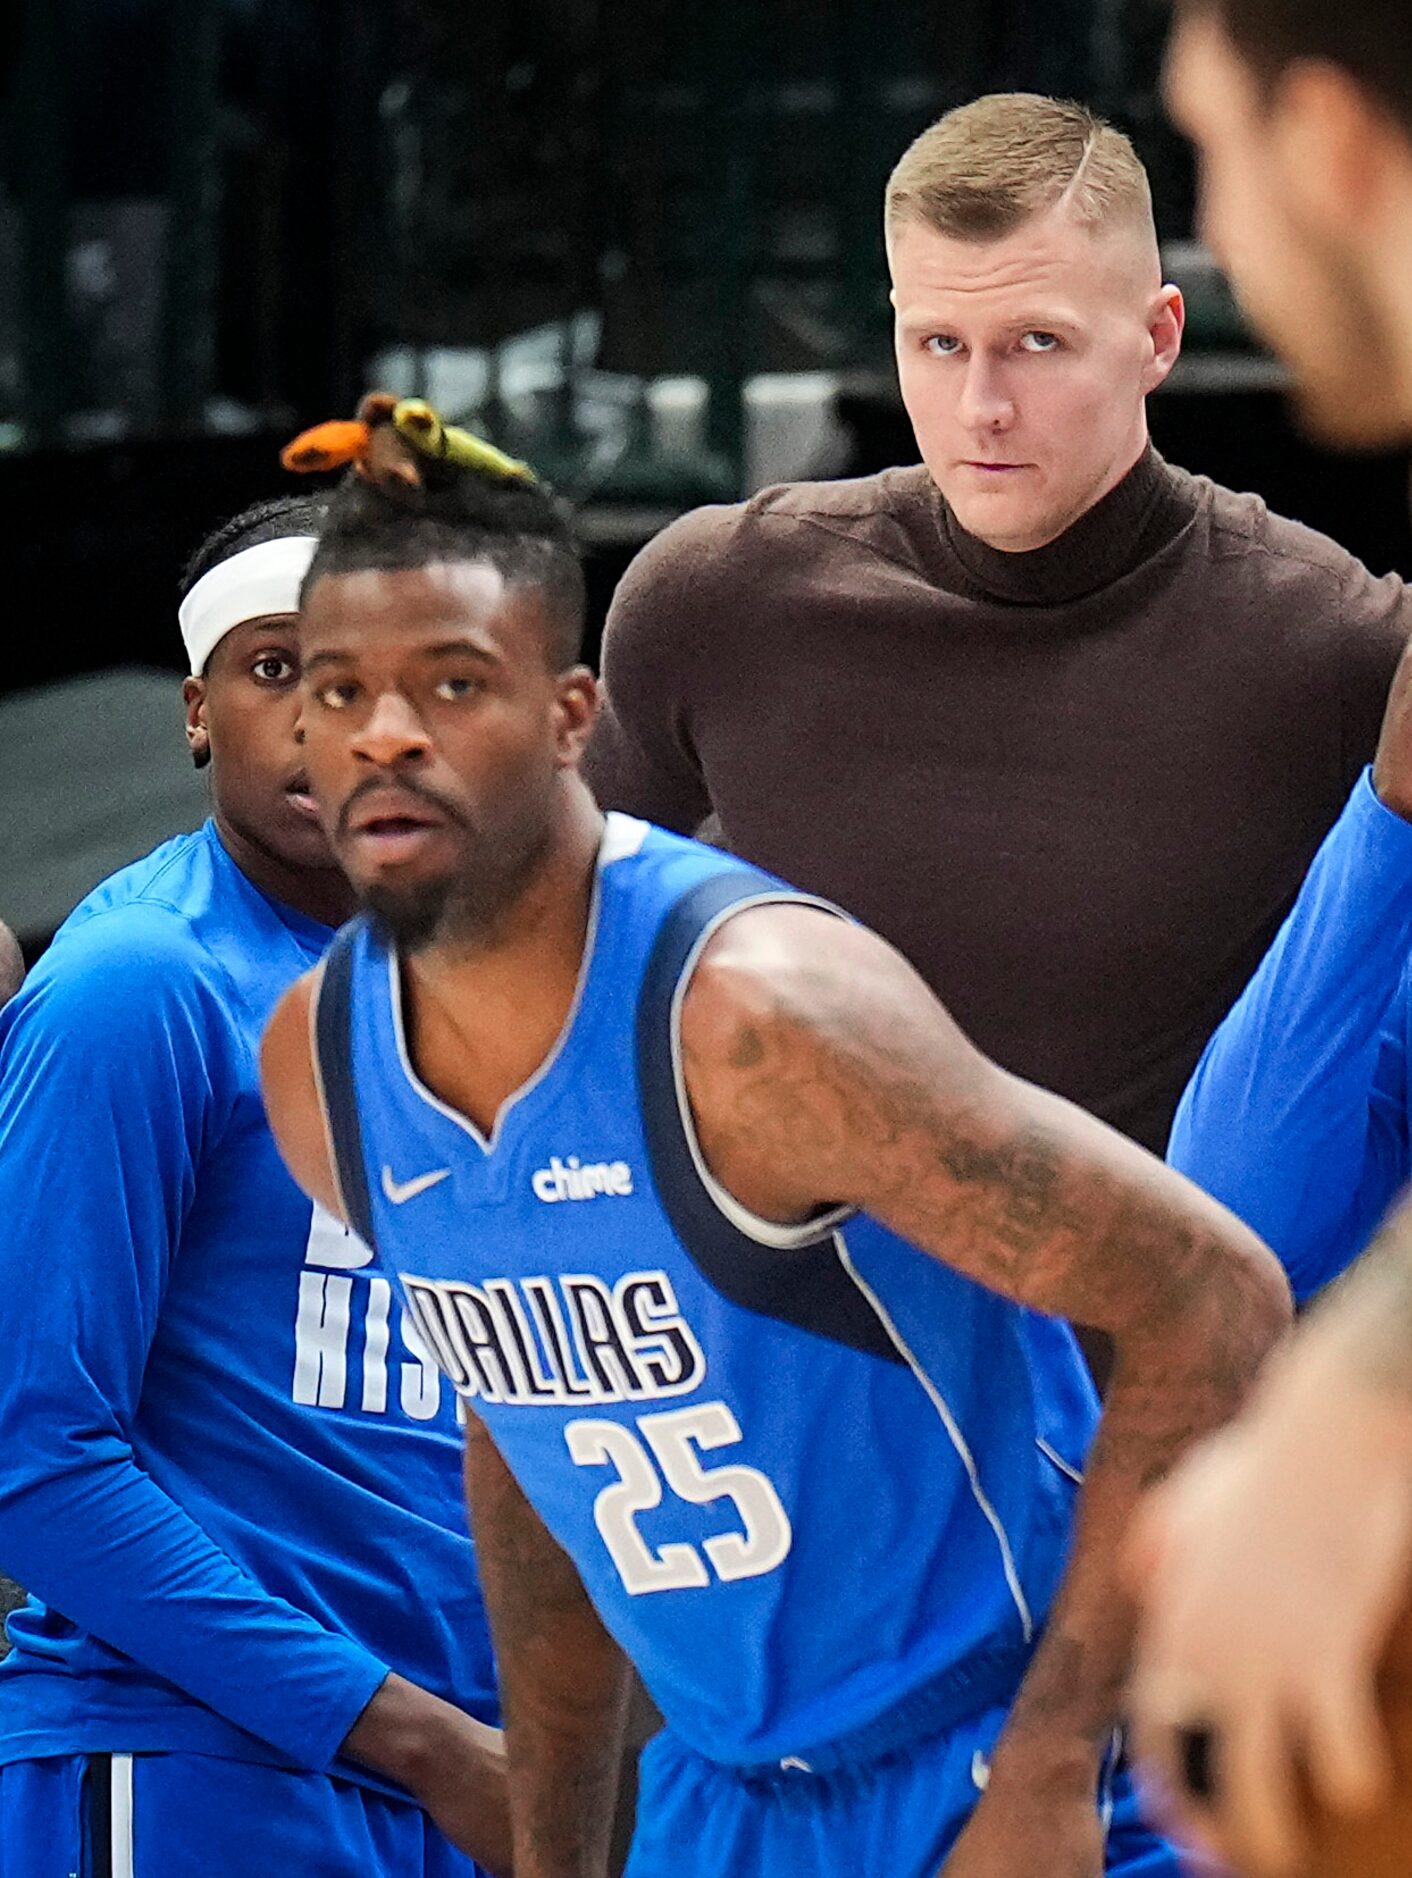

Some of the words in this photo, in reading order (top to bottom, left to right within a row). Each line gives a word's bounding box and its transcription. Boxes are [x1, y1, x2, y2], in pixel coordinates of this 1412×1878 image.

[532, 1155, 633, 1203] chime
[293, 1270, 466, 1425] HIS
[399, 1270, 706, 1406] DALLAS
[564, 1402, 792, 1595] 25
